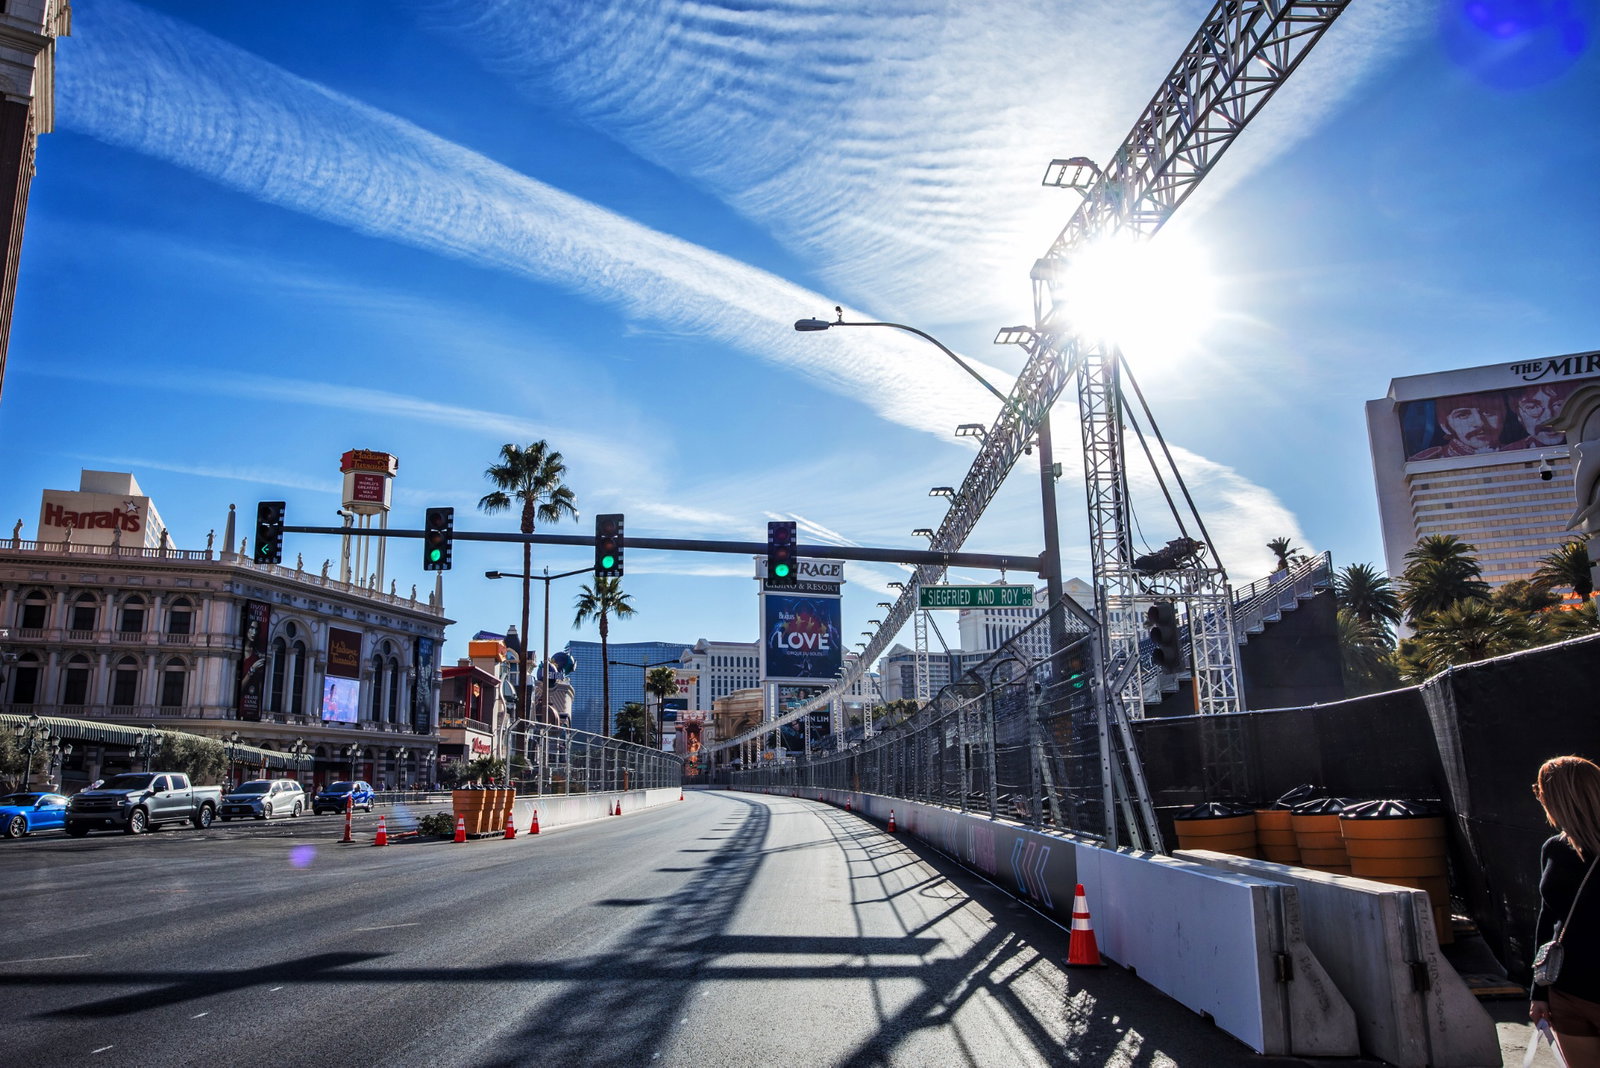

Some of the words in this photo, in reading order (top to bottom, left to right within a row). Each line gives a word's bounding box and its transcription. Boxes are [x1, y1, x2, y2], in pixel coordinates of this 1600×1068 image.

[1510, 362, 1542, 375] THE
[797, 562, 841, 577] RAGE
[806, 583, 840, 592] RESORT
[1022, 587, 1032, 595] DR
[928, 589, 971, 605] SIEGFRIED
[977, 589, 995, 605] AND
[1001, 588, 1019, 604] ROY
[777, 630, 830, 650] LOVE
